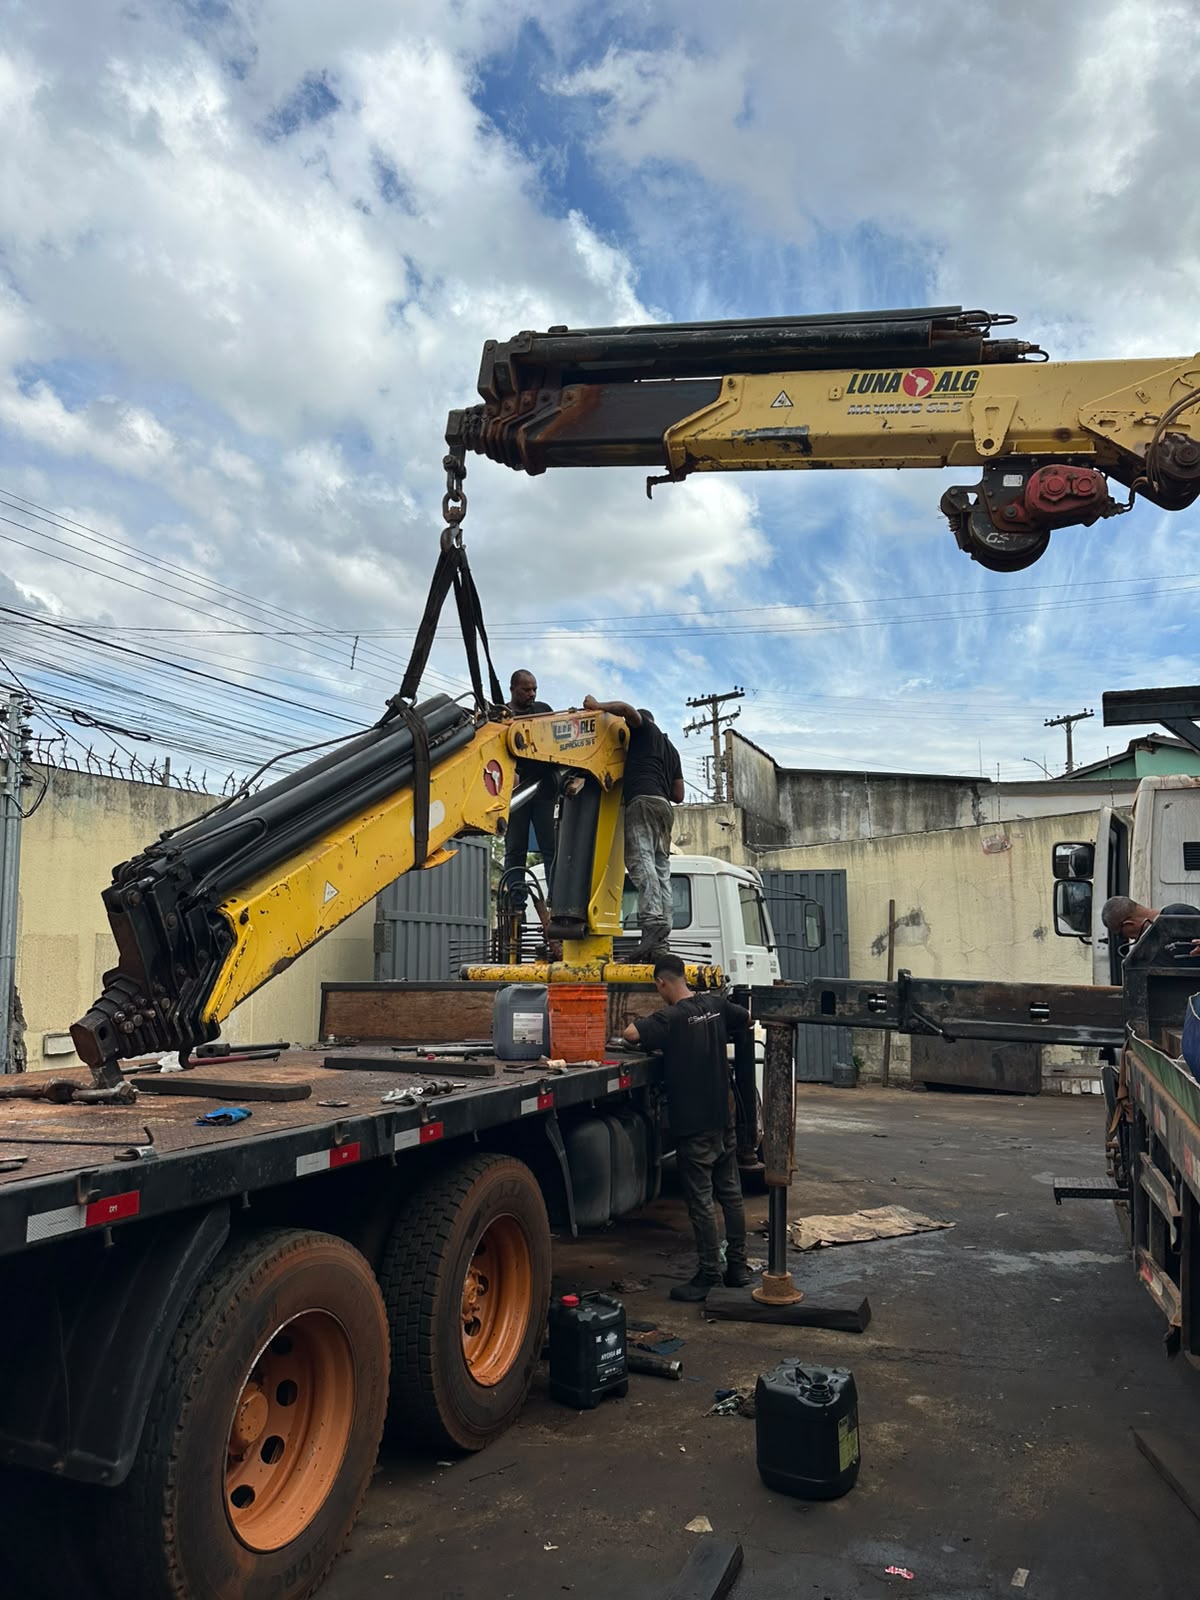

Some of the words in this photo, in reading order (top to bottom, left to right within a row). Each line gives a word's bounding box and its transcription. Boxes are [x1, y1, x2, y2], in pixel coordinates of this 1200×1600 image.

[846, 371, 903, 394] LUNA
[934, 370, 979, 392] ALG
[847, 402, 923, 415] MAXIMUS
[581, 719, 595, 733] ALG
